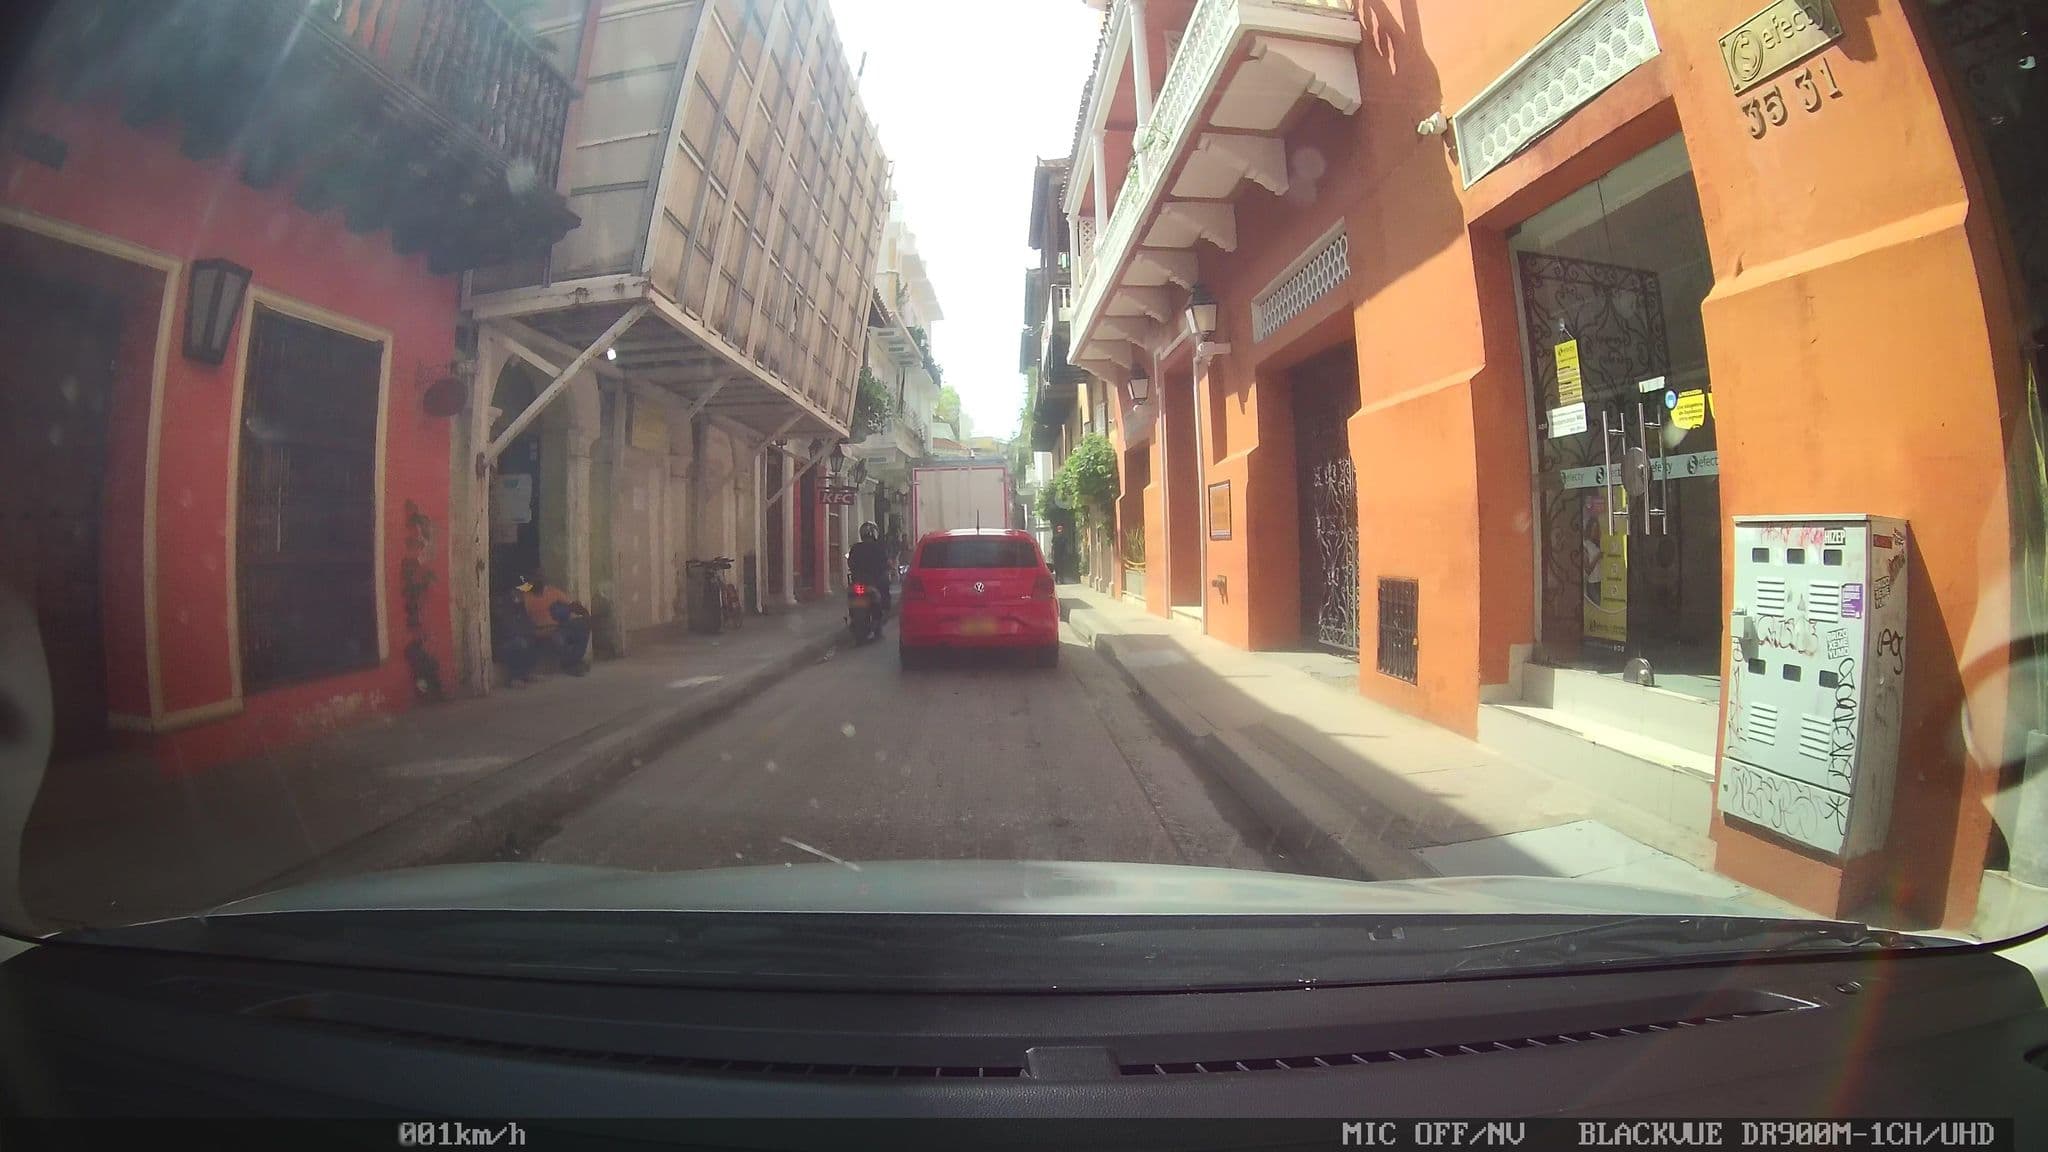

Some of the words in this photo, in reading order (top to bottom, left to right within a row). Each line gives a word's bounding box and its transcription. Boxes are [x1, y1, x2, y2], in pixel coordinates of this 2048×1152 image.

[1741, 85, 1788, 139] 35
[1795, 56, 1843, 113] 31
[822, 493, 852, 504] KFC
